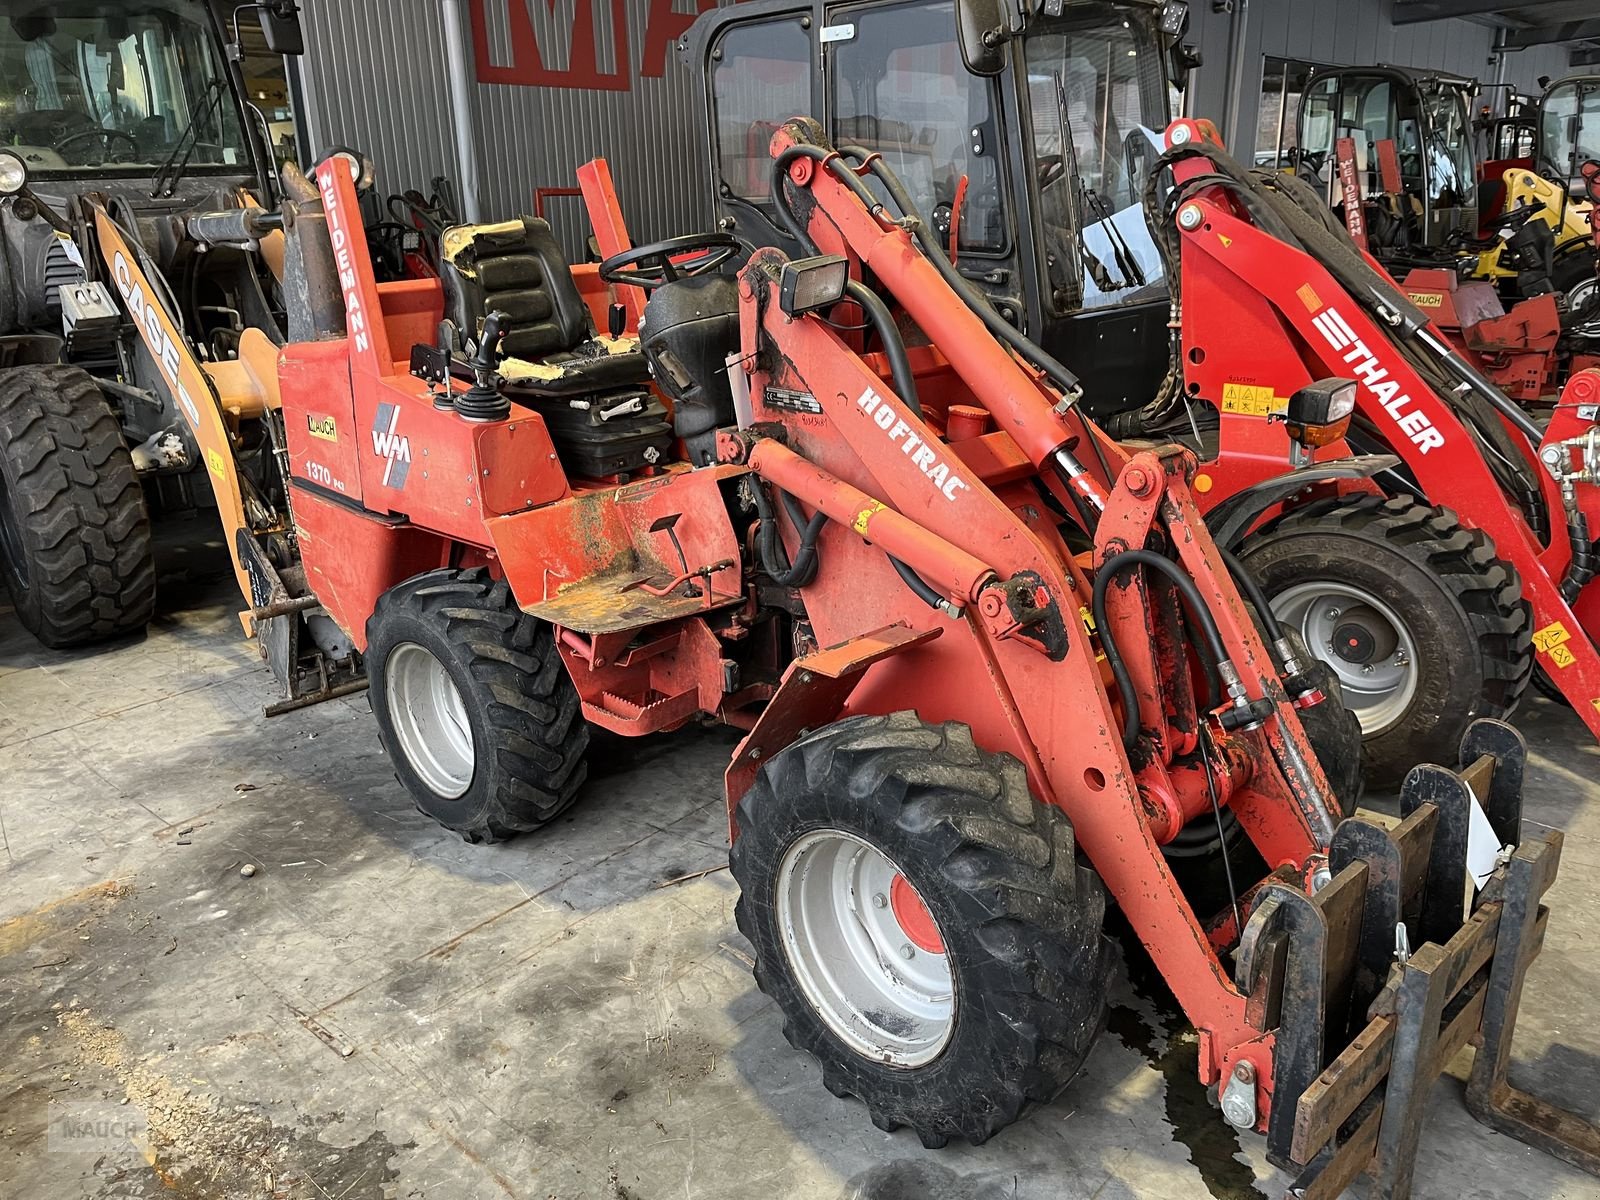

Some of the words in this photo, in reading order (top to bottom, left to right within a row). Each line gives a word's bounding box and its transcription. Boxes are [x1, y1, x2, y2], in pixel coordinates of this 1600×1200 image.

[114, 250, 181, 388] CASE
[320, 171, 369, 353] WEIDEMANN
[305, 461, 331, 485] 1370
[857, 385, 966, 502] HOFTRAC
